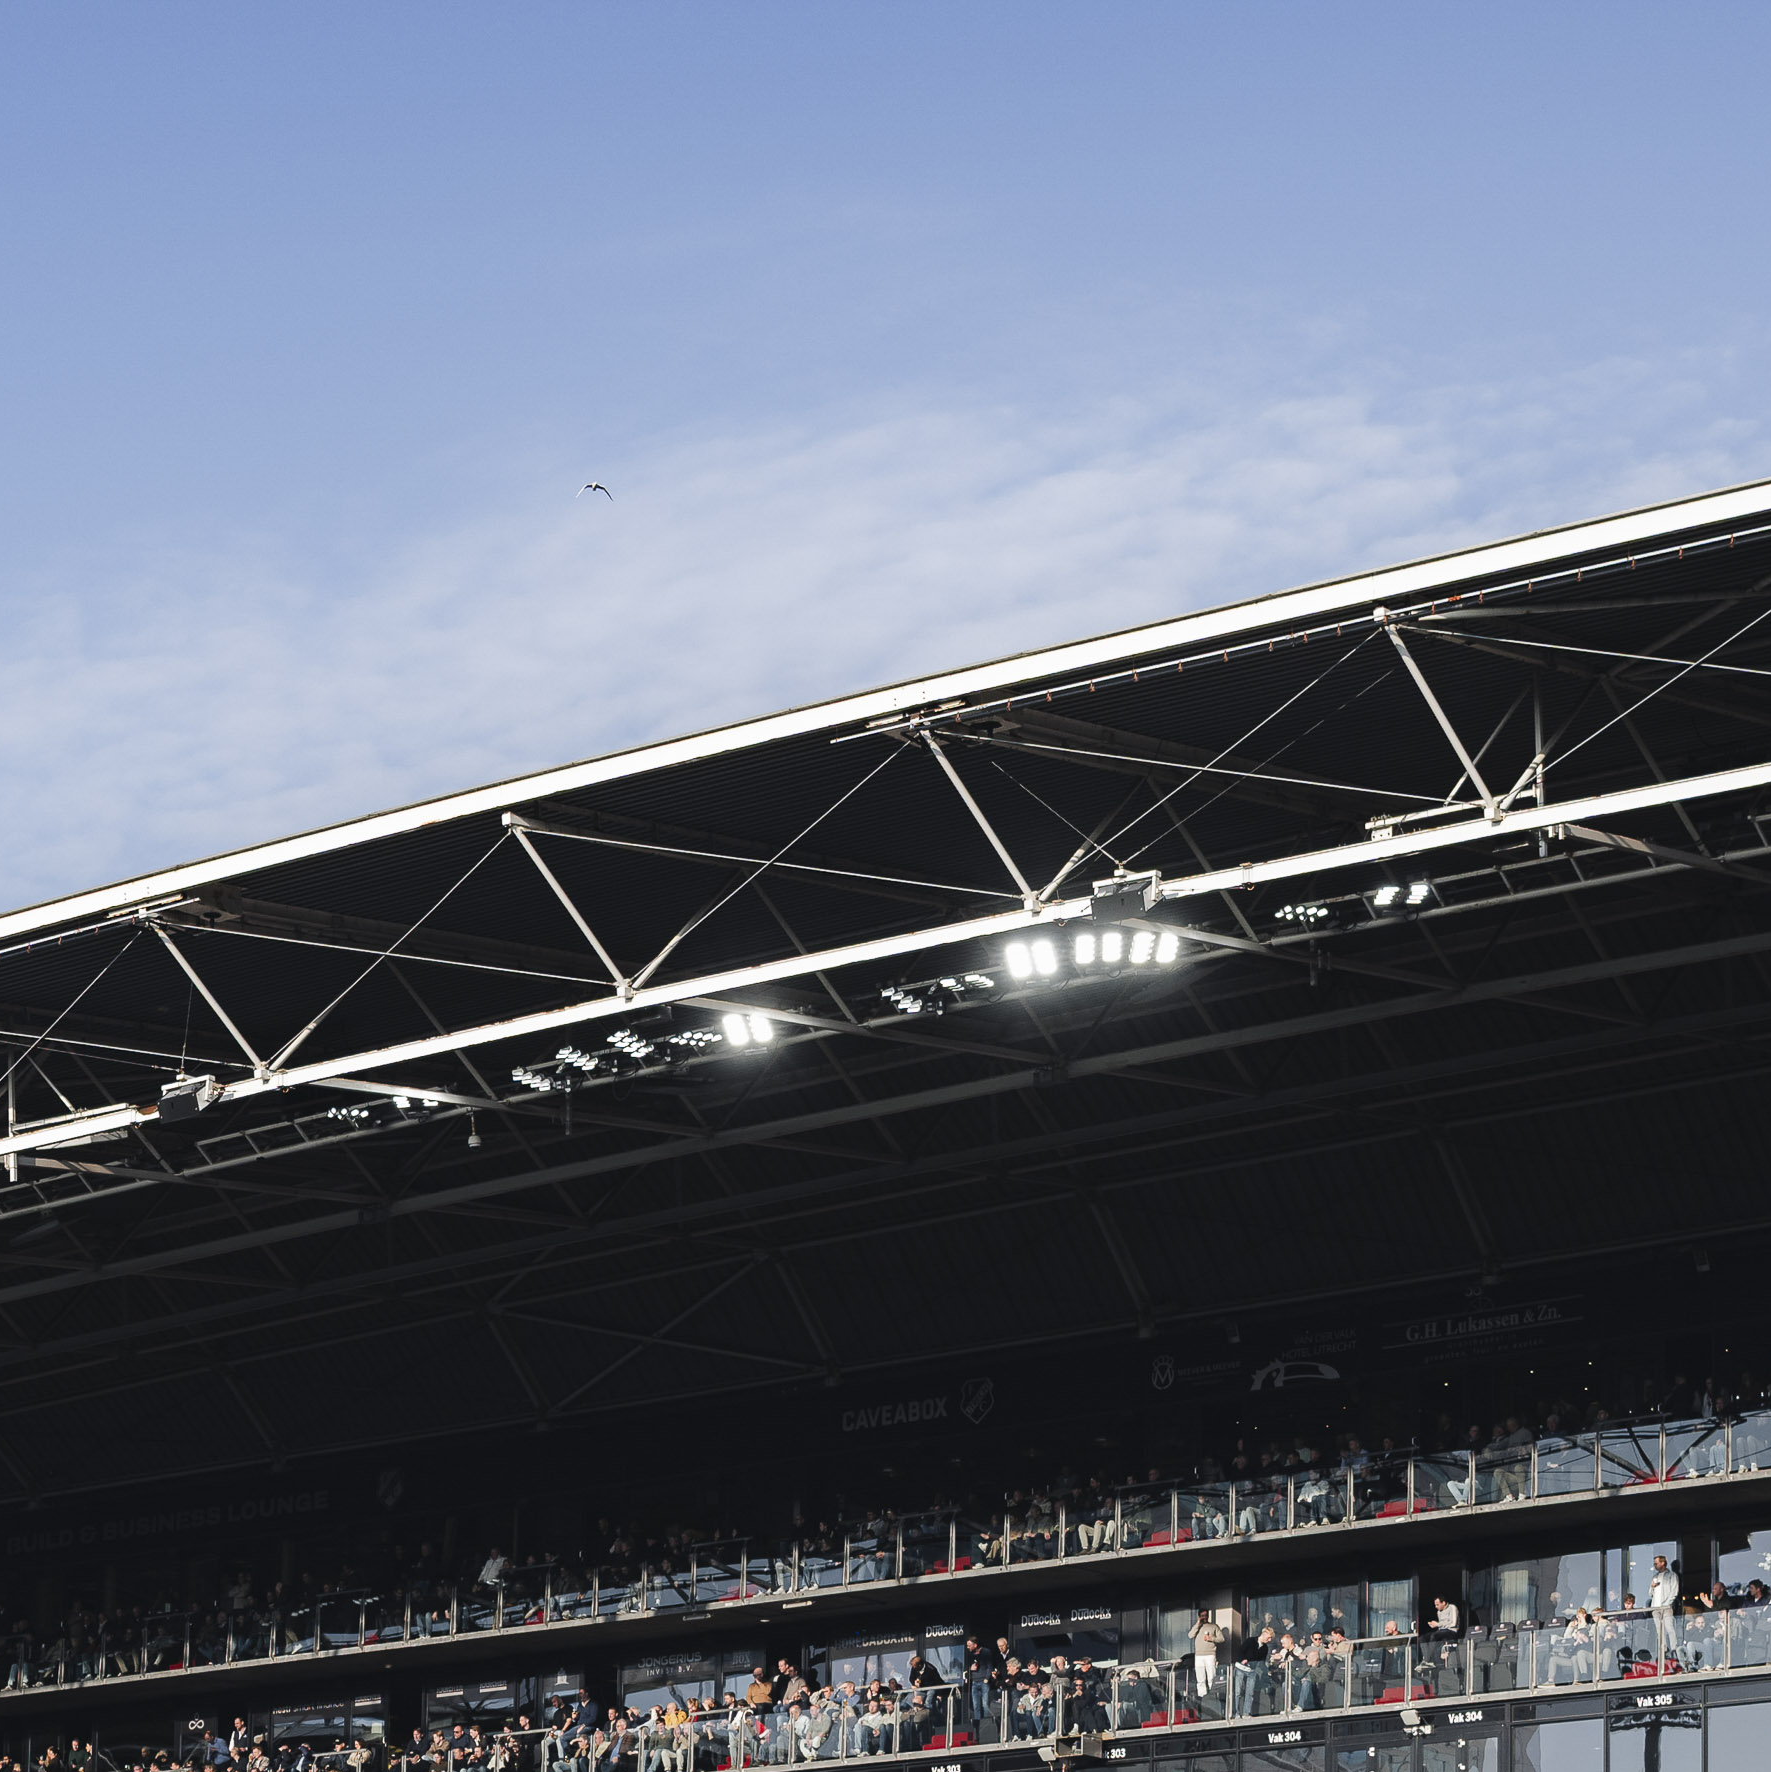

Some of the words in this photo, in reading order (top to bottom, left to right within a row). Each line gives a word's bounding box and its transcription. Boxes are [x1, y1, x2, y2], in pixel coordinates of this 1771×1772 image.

[1447, 1312, 1519, 1336] Lukassen
[841, 1396, 948, 1432] CAVEABOX
[7, 1529, 73, 1556] BUILD
[102, 1506, 222, 1541] BUSINESS
[228, 1489, 329, 1523] LOUNGE
[638, 1651, 703, 1669] JONGERIUS
[1637, 1696, 1653, 1707] Vak
[1655, 1694, 1672, 1705] 305
[1448, 1713, 1464, 1723] Vak
[1465, 1711, 1482, 1722] 304
[1268, 1733, 1283, 1743] Vak
[1285, 1731, 1301, 1742] 304
[1111, 1748, 1127, 1759] 303
